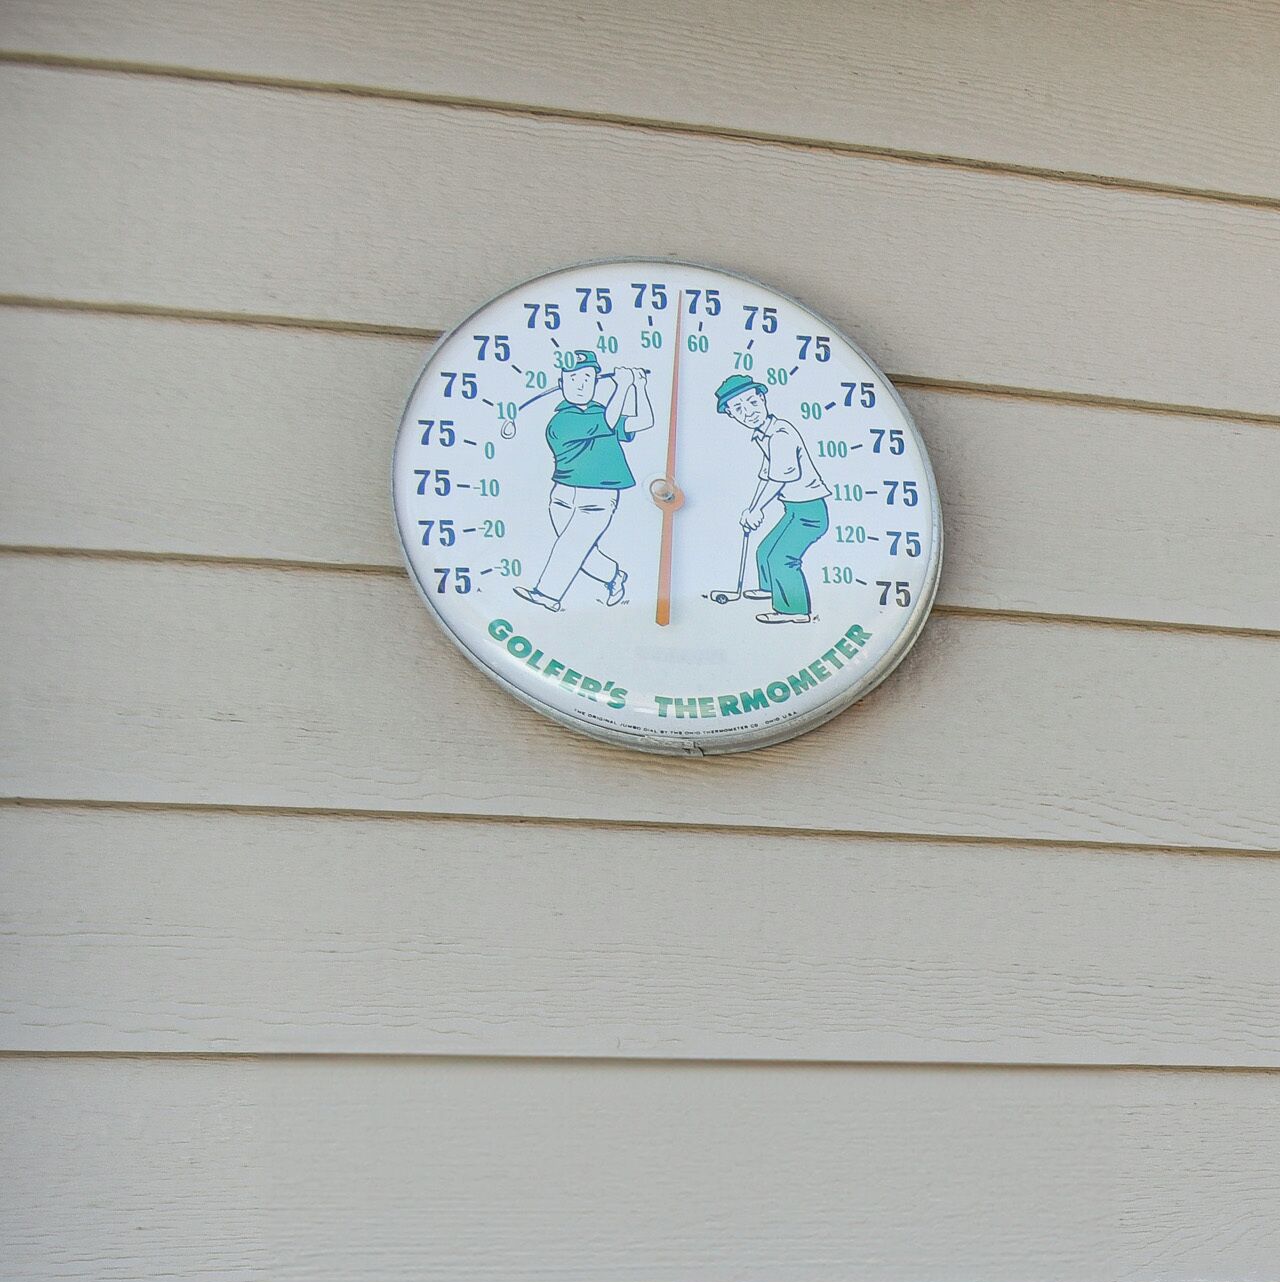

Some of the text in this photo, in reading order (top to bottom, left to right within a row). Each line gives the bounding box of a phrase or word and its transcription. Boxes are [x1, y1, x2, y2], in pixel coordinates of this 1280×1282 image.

[575, 287, 613, 315] 75
[630, 283, 668, 310] 75
[685, 288, 722, 317] 75
[523, 303, 561, 331] 75
[742, 305, 778, 334] 75
[473, 334, 511, 362] 75
[596, 335, 619, 354] 40
[640, 330, 663, 350] 50
[687, 334, 709, 353] 60
[796, 335, 831, 363] 75
[553, 350, 575, 369] 30
[733, 351, 754, 372] 70
[440, 371, 478, 400] 75
[524, 370, 548, 389] 20
[766, 367, 789, 386] 80
[840, 382, 876, 409] 75
[496, 401, 519, 420] 10
[800, 401, 823, 421] 90
[417, 419, 456, 448] 75
[869, 428, 905, 456] 75
[484, 441, 496, 460] 0
[817, 439, 848, 459] 100
[413, 469, 451, 497] 75
[834, 483, 864, 503] 110
[883, 480, 919, 507] 75
[417, 519, 456, 547] 75
[835, 525, 866, 544] 120
[886, 530, 922, 558] 75
[433, 566, 472, 595] 75
[822, 566, 853, 585] 130
[875, 580, 911, 608] 75
[487, 618, 873, 720] GOLFER'S THERMOMETER
